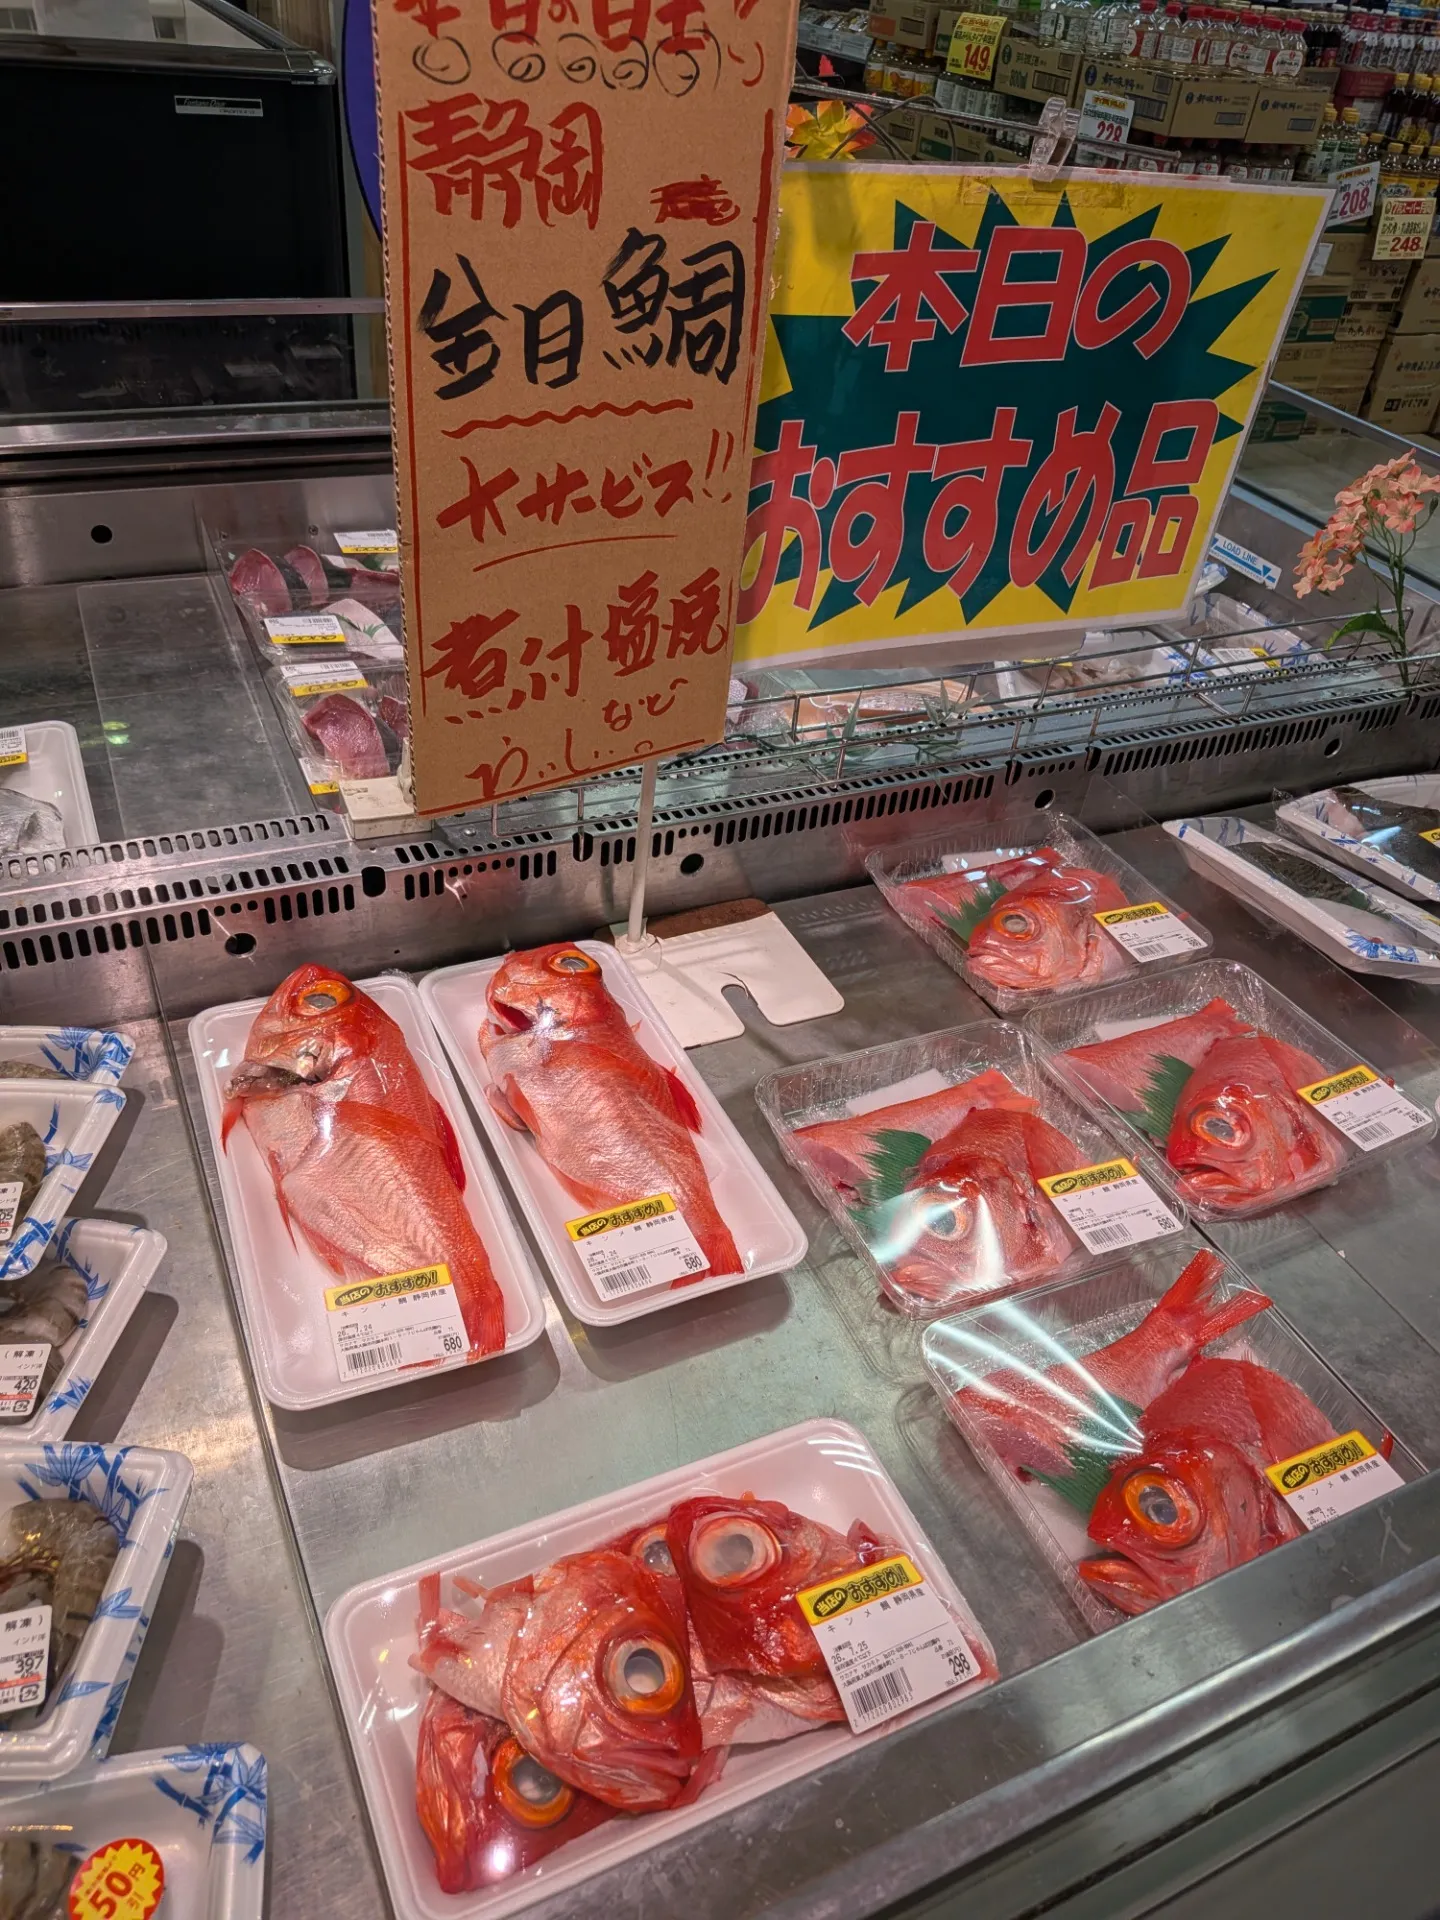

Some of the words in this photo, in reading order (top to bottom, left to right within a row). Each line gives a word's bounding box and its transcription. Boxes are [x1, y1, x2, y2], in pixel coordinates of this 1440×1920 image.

[842, 220, 1194, 373] 本日の
[417, 226, 746, 401] 金目鯛
[736, 398, 1220, 625] おすすめ品
[1222, 539, 1242, 557] LOAD
[1241, 549, 1259, 566] LINE
[443, 1336, 463, 1352] 680
[14, 1655, 45, 1675] 397
[948, 1652, 971, 1676] 298
